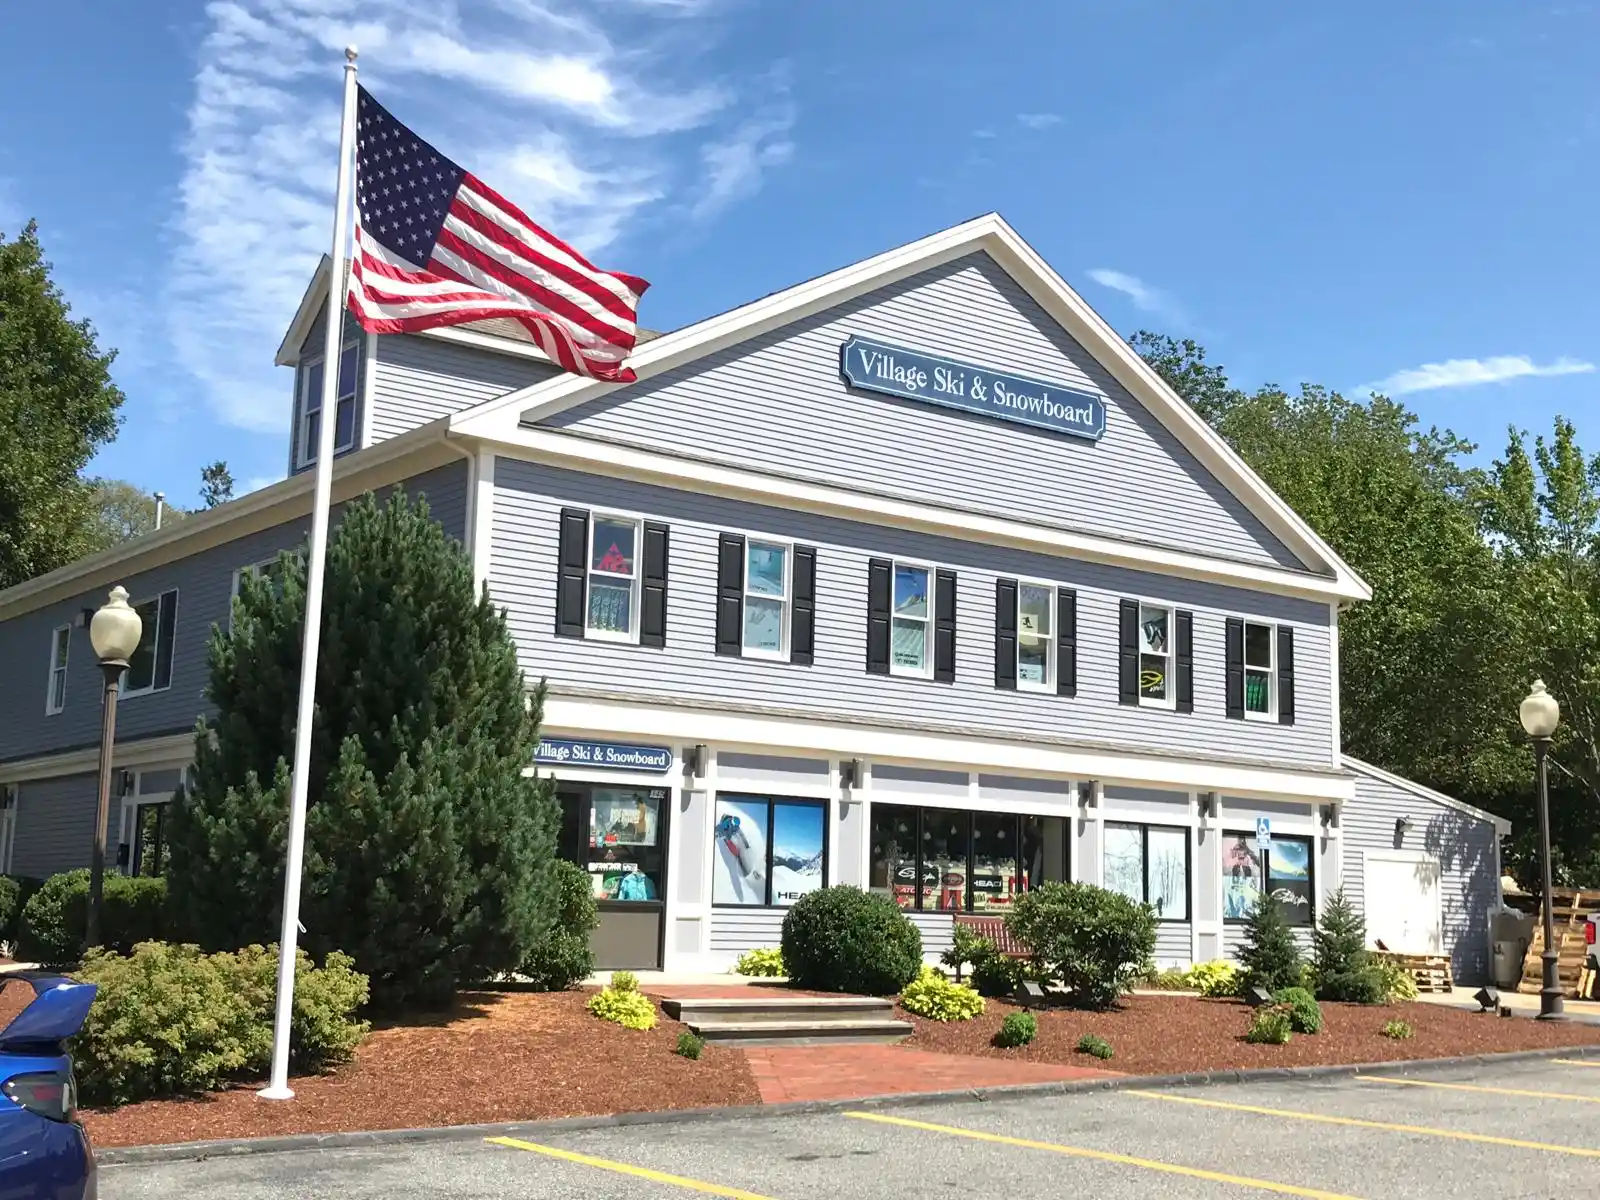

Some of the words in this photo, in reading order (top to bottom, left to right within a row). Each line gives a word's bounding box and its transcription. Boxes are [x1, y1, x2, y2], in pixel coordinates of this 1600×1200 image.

[858, 347, 927, 391] Village
[933, 366, 965, 396] Ski
[970, 375, 988, 401] &
[993, 380, 1094, 426] Snowboard
[572, 744, 591, 760] Ski
[593, 746, 604, 761] &
[606, 747, 666, 766] Snowboard
[777, 891, 807, 900] HEA
